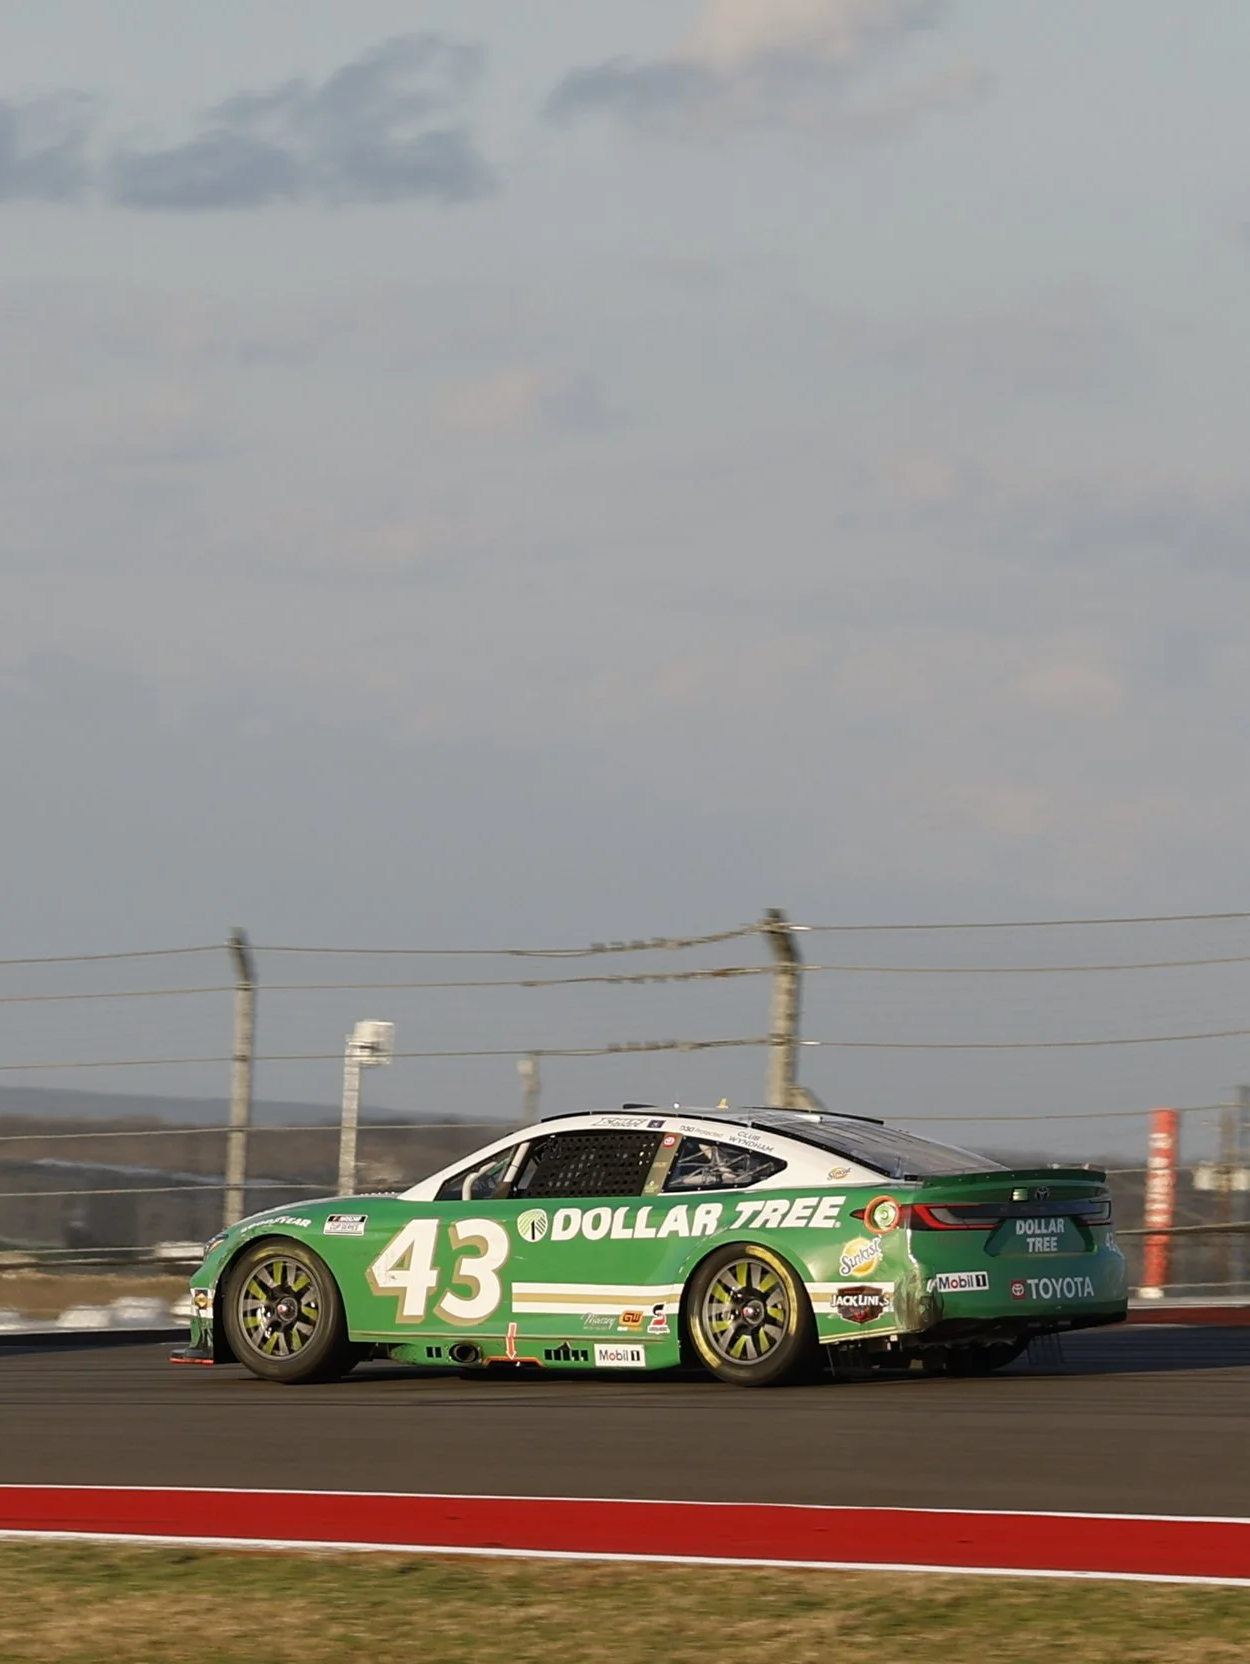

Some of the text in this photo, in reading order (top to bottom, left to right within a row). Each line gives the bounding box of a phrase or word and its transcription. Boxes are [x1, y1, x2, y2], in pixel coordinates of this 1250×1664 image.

[728, 1136, 774, 1153] WYNDHAM
[737, 1131, 761, 1141] CLUB
[550, 1196, 847, 1241] DOLLAR TREE
[1015, 1217, 1065, 1236] DOLLAR
[1026, 1236, 1058, 1253] TREE
[839, 1236, 883, 1277] Sunkist
[364, 1217, 511, 1327] 43
[938, 1277, 975, 1290] Mobil
[1026, 1276, 1095, 1300] TOYOTA
[831, 1294, 858, 1308] JACK
[599, 1349, 629, 1362] Mobil
